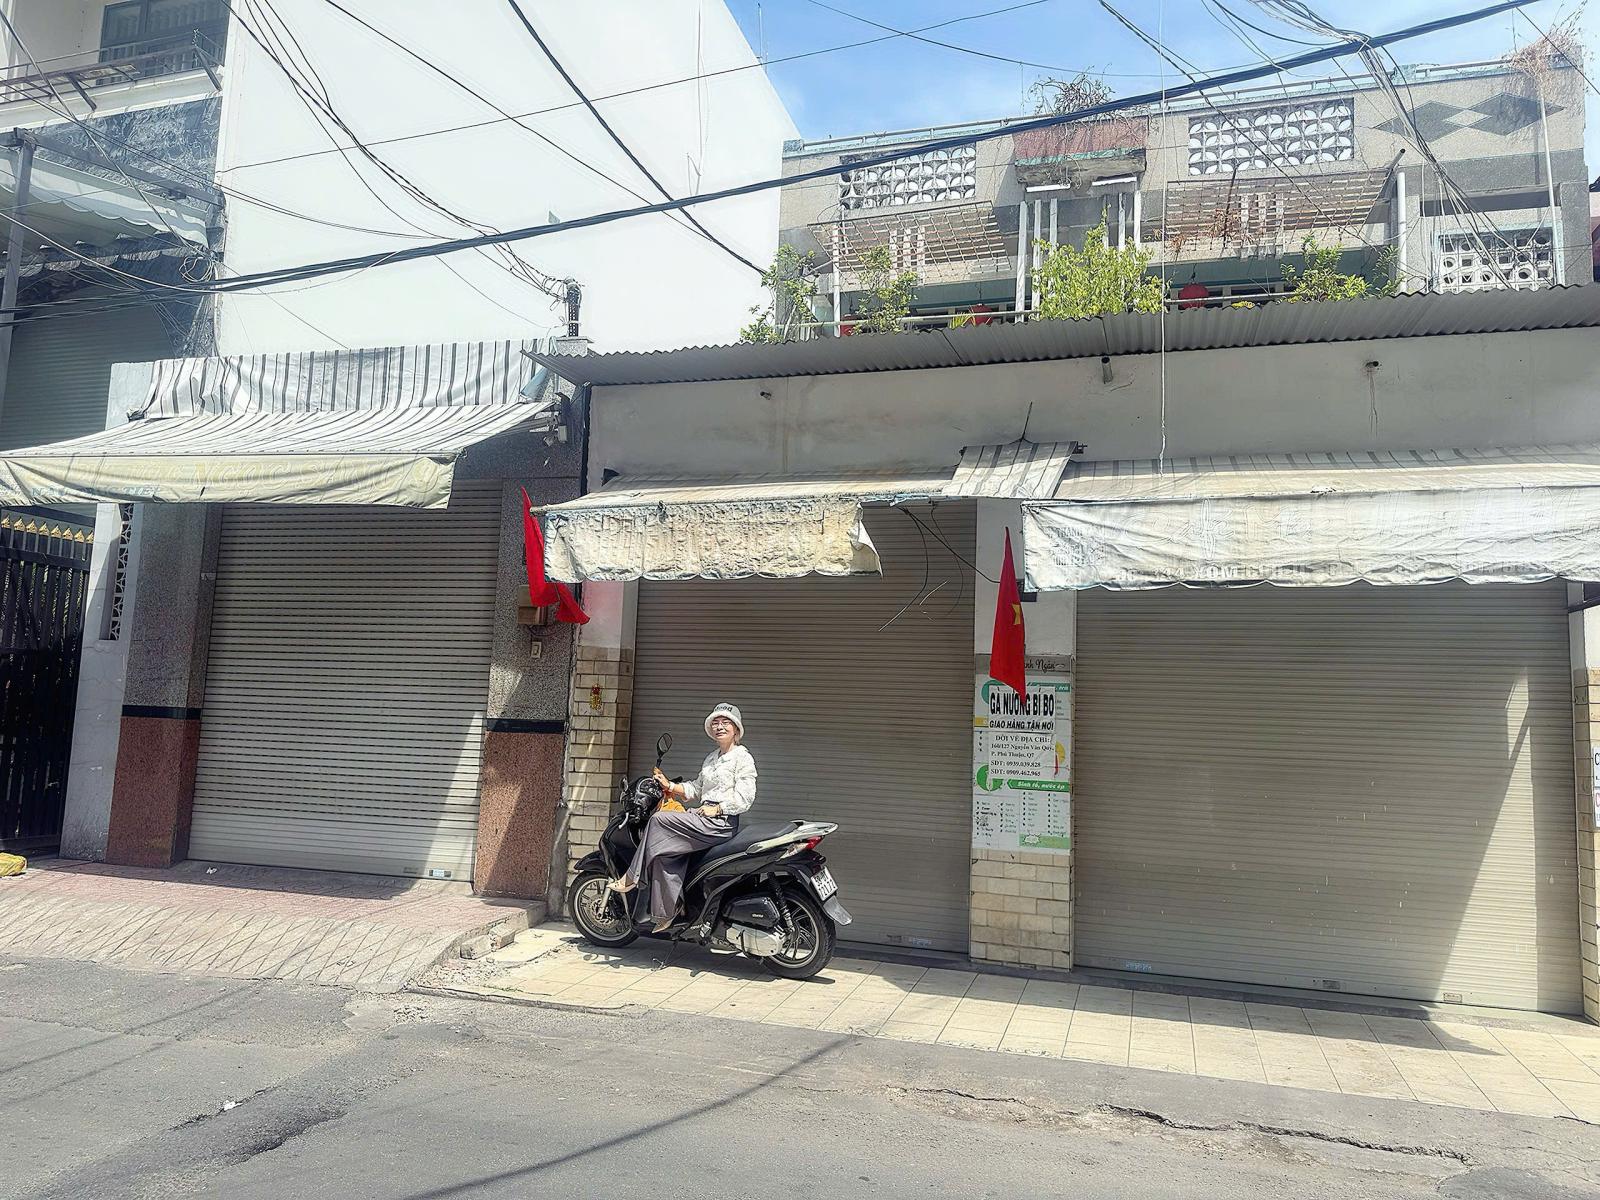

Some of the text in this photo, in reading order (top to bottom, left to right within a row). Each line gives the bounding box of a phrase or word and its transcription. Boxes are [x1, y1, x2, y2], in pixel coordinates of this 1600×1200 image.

[990, 686, 1001, 715] GÀ
[1032, 687, 1041, 716] BÍ
[989, 720, 1006, 729] GIAO
[1041, 721, 1054, 731] NƠI
[1010, 743, 1030, 752] Nguyễn
